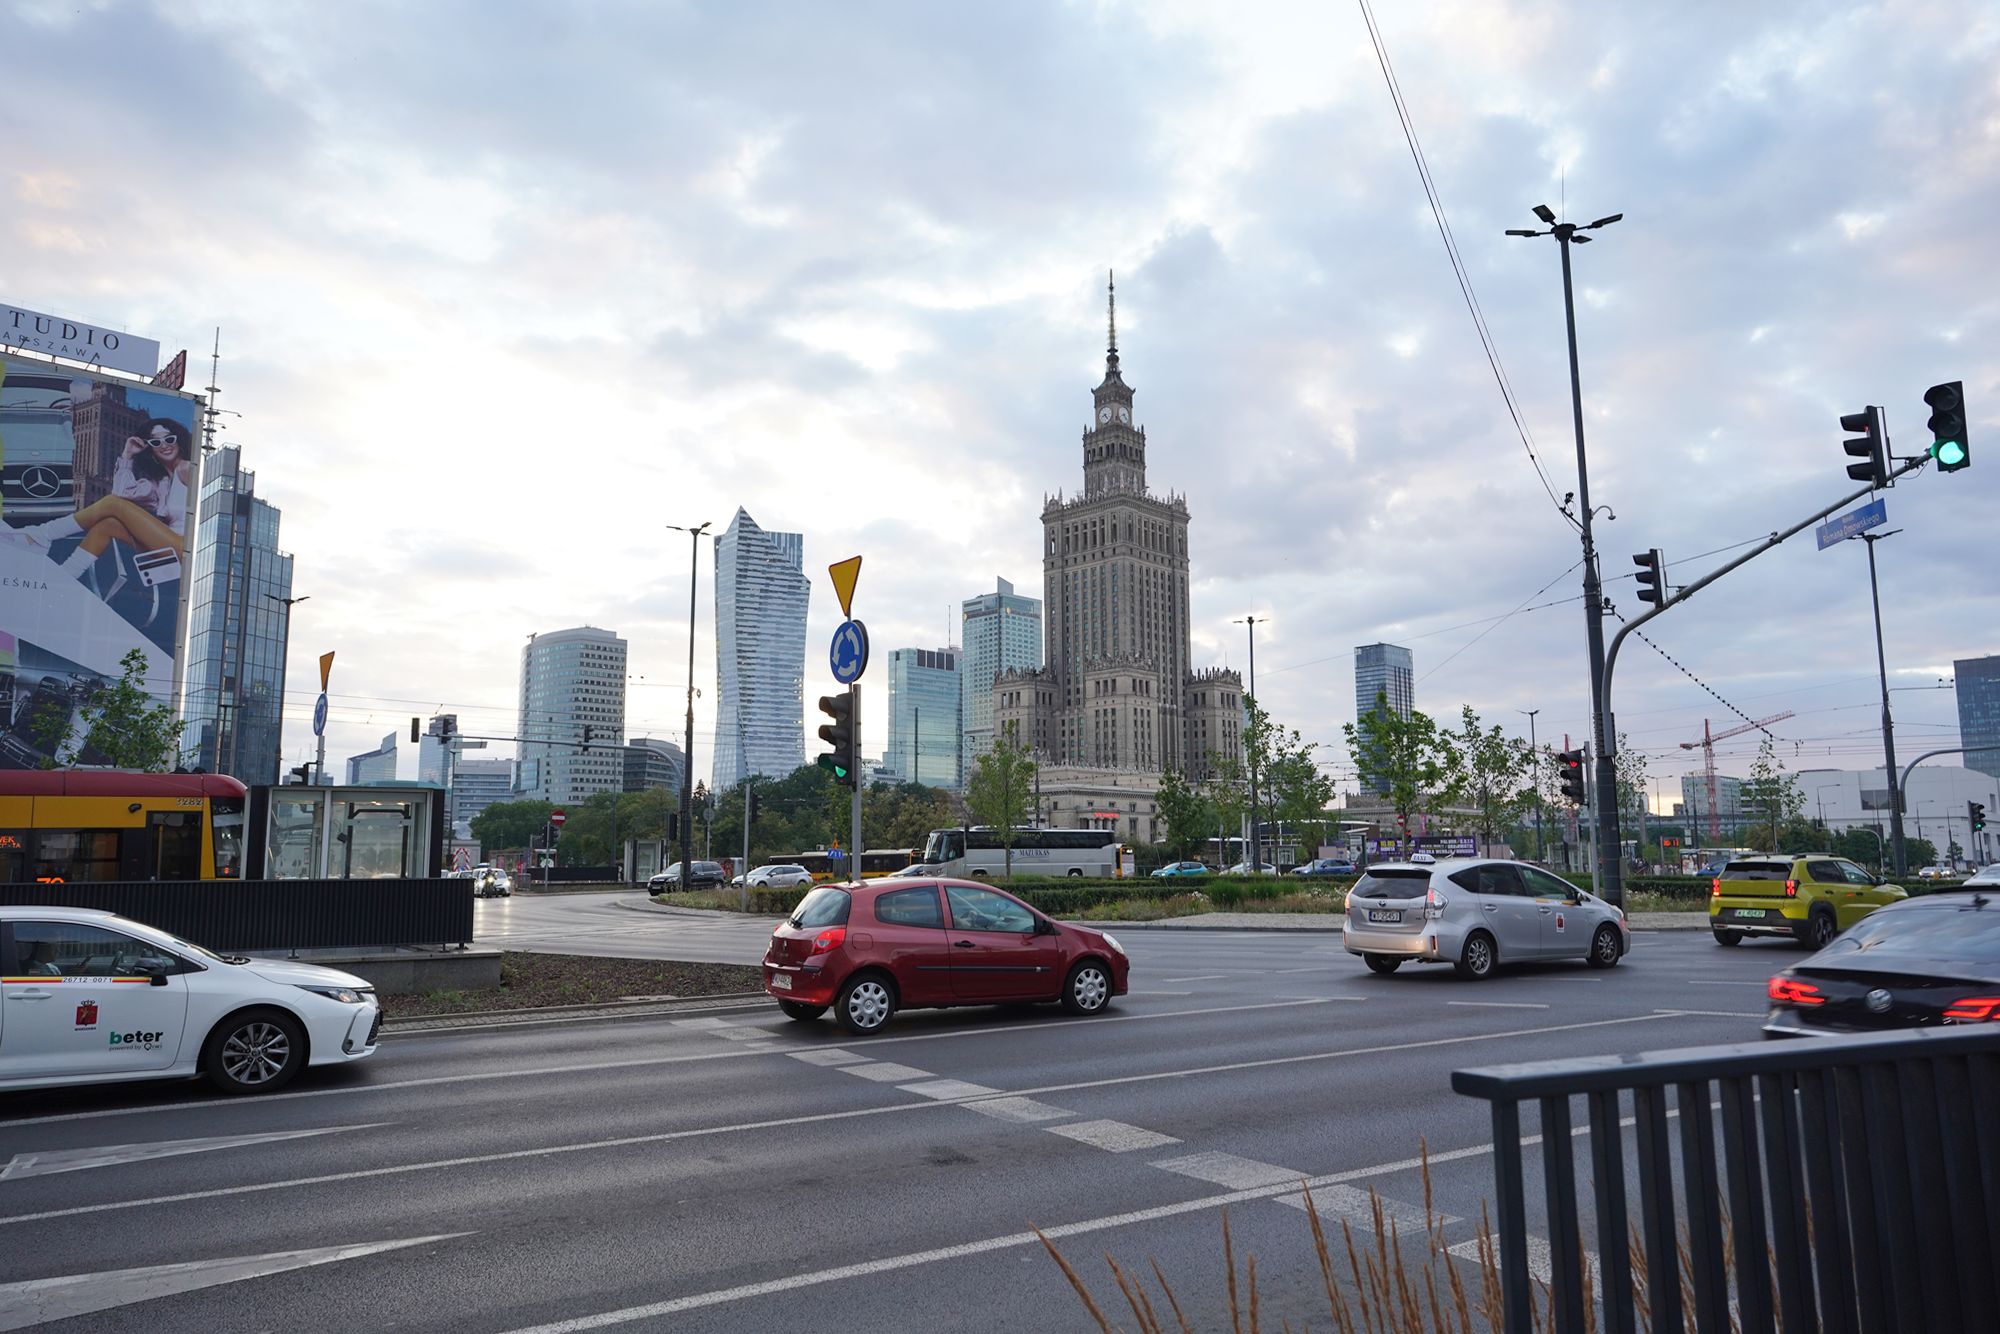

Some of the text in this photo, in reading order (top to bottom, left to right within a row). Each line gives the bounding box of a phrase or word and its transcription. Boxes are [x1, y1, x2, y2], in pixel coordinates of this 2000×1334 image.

[9, 310, 119, 351] TUDIO
[3, 577, 48, 590] EŚNIA
[109, 1031, 164, 1044] beter
[134, 1043, 142, 1051] by
